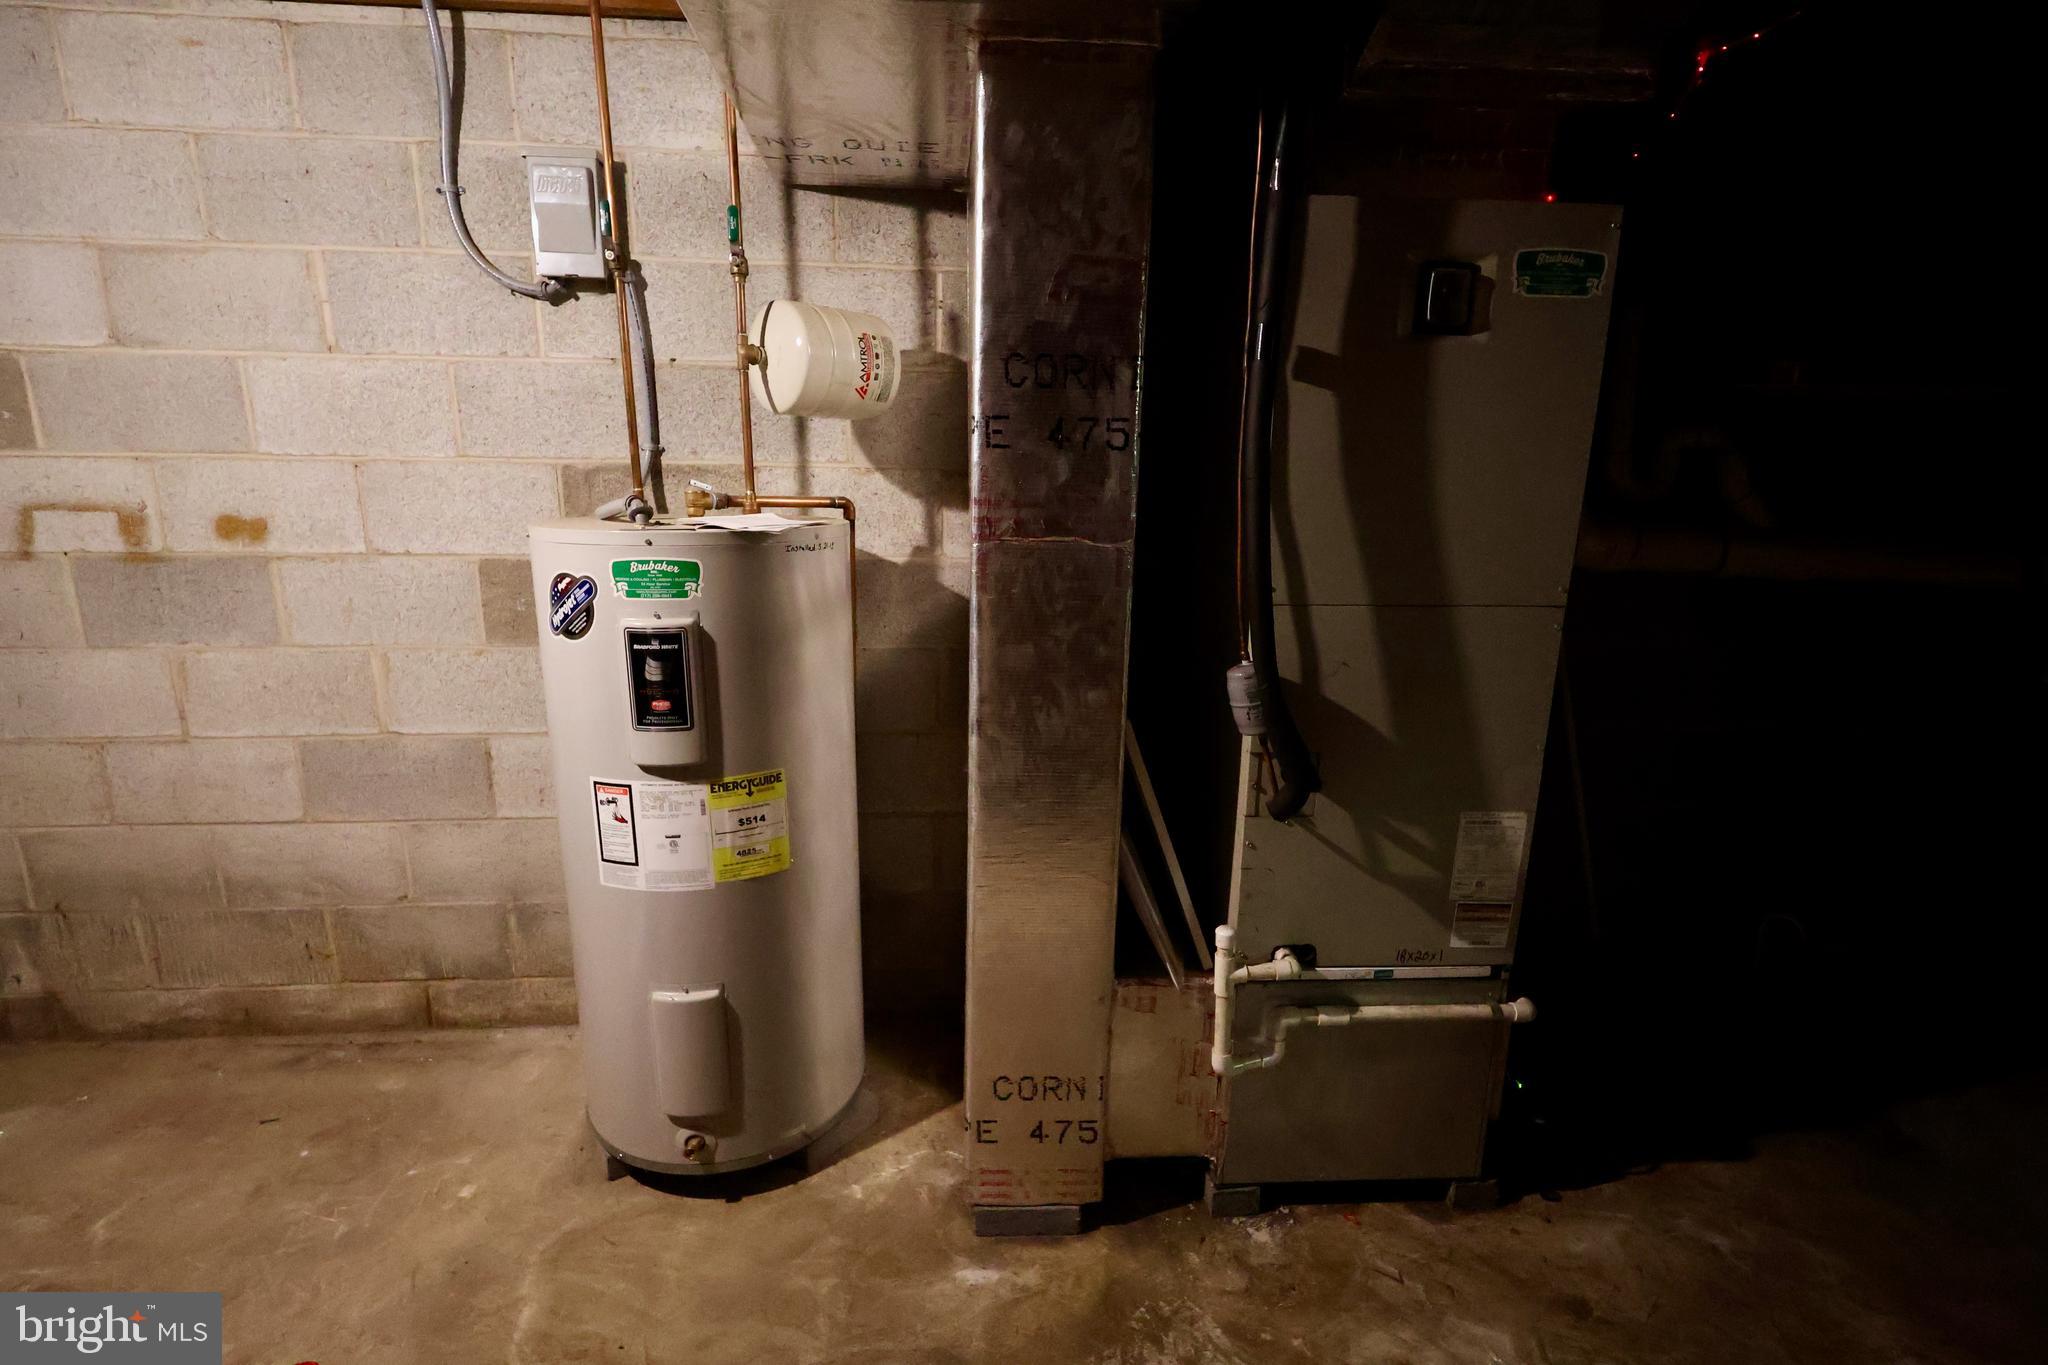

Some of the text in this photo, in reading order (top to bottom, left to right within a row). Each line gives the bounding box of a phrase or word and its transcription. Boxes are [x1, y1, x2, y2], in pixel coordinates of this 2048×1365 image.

[857, 335, 870, 383] AMTROL
[1048, 416, 1130, 451] 475
[629, 560, 680, 573] Brubaker
[551, 593, 577, 628] Hydrojet
[710, 773, 782, 797] ENERGYGUIDE
[738, 814, 766, 827] $514
[1030, 1119, 1099, 1145] 475
